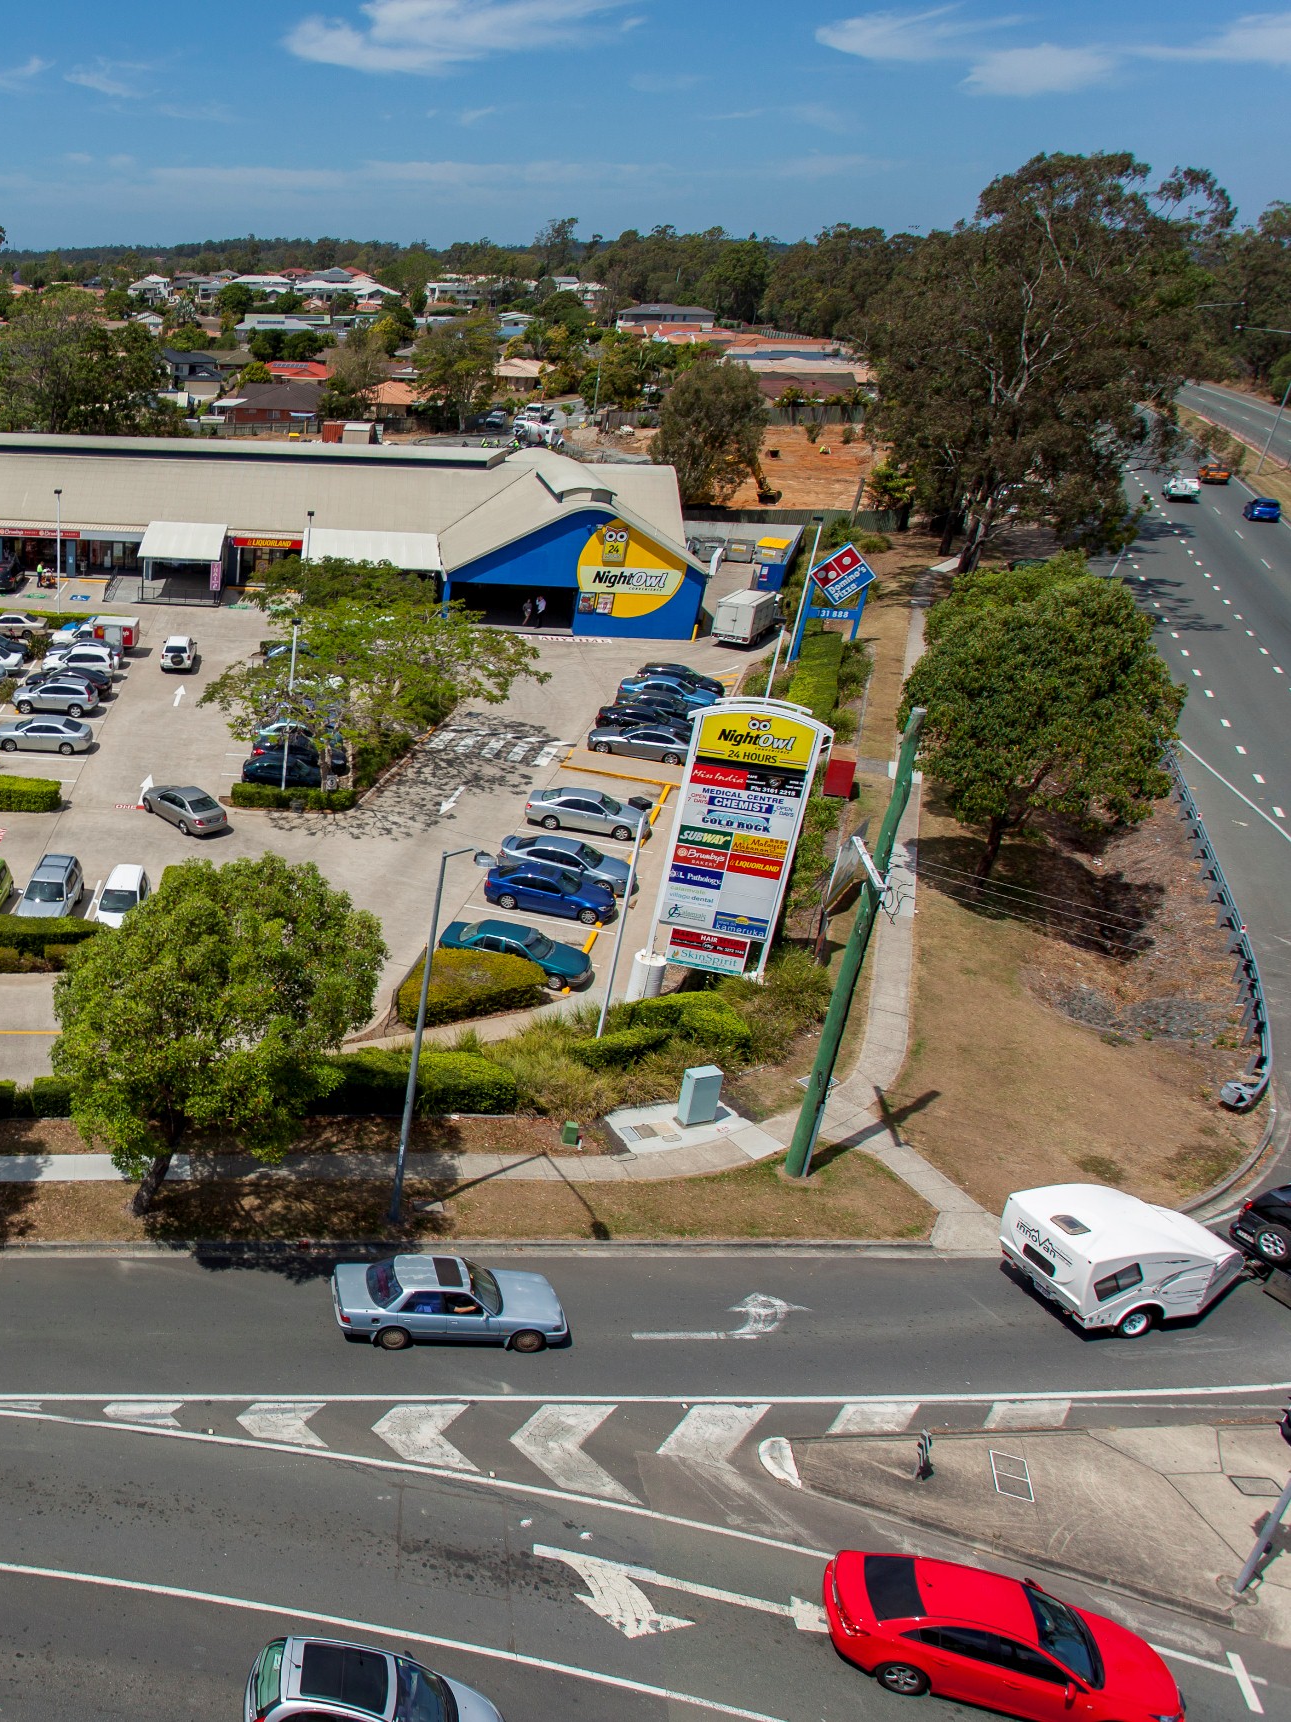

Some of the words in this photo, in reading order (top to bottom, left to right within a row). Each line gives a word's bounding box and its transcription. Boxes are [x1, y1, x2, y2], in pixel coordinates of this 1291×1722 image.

[252, 539, 292, 547] LIQUORLAND
[608, 545, 619, 554] 24
[592, 570, 668, 588] NightOwl
[828, 566, 867, 594] Domino's
[833, 582, 857, 601] Pizza
[832, 610, 849, 618] 888
[718, 728, 797, 751] NightOwl
[728, 750, 740, 759] 24
[743, 751, 777, 764] HOURS
[692, 769, 713, 779] Miss
[714, 772, 744, 784] India
[691, 792, 708, 800] OPEN
[702, 787, 743, 799] MEDICAL
[747, 794, 785, 805] CENTRE
[714, 797, 769, 813] CHEMIST
[679, 830, 731, 845] SUBWAY
[750, 838, 788, 851] Malaysia
[691, 859, 717, 867] BAKERY
[735, 859, 780, 872] LIQUORLAND
[670, 884, 707, 895] calamvale
[691, 895, 714, 904] dental
[715, 922, 765, 937] kameruka
[700, 935, 718, 943] HAIR
[681, 949, 738, 967] SkinSpirit
